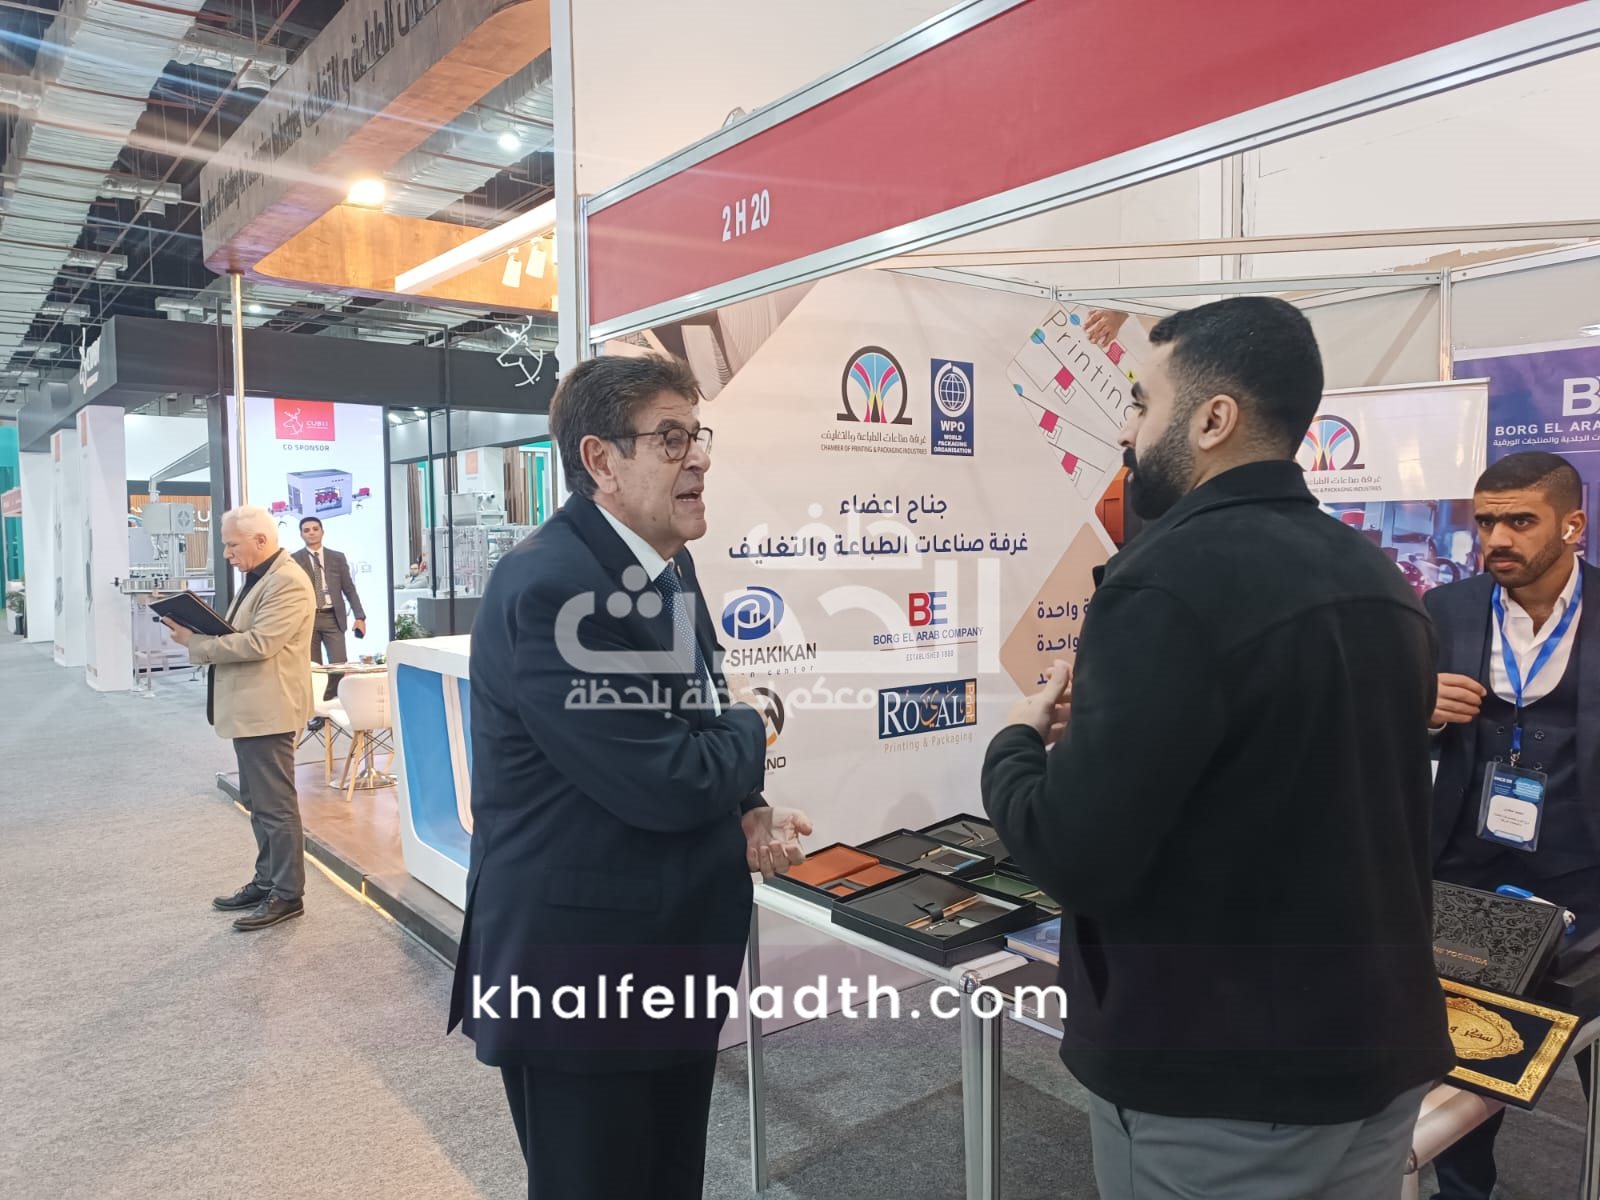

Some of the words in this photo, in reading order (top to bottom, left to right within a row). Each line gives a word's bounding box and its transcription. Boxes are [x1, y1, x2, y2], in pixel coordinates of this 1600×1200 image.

[722, 205, 732, 242] 2
[735, 198, 747, 237] H
[751, 188, 770, 231] 20
[1562, 376, 1600, 416] B
[821, 430, 856, 442] والتغليف
[857, 431, 882, 442] الطباعة
[940, 420, 965, 433] WPO
[1495, 424, 1538, 436] BORG
[1544, 422, 1563, 433] EL
[1570, 420, 1600, 432] ARA
[883, 432, 908, 443] صناعات
[909, 434, 927, 445] غرفة
[821, 444, 843, 452] CHAMBER
[852, 445, 873, 453] PRINTING
[907, 494, 947, 523] جناح
[729, 536, 827, 564] والتغليف
[834, 534, 908, 560] الطباعة
[915, 532, 984, 554] صناعات
[989, 532, 1028, 556] غرفة
[1037, 600, 1078, 620] واحدة
[873, 633, 900, 645] BORG
[902, 633, 914, 643] EL
[916, 630, 939, 642] ARAB
[942, 626, 984, 639] COMPANY
[726, 642, 817, 667] -SHAKIKAN
[884, 740, 919, 753] Printing
[932, 732, 973, 746] Packaging
